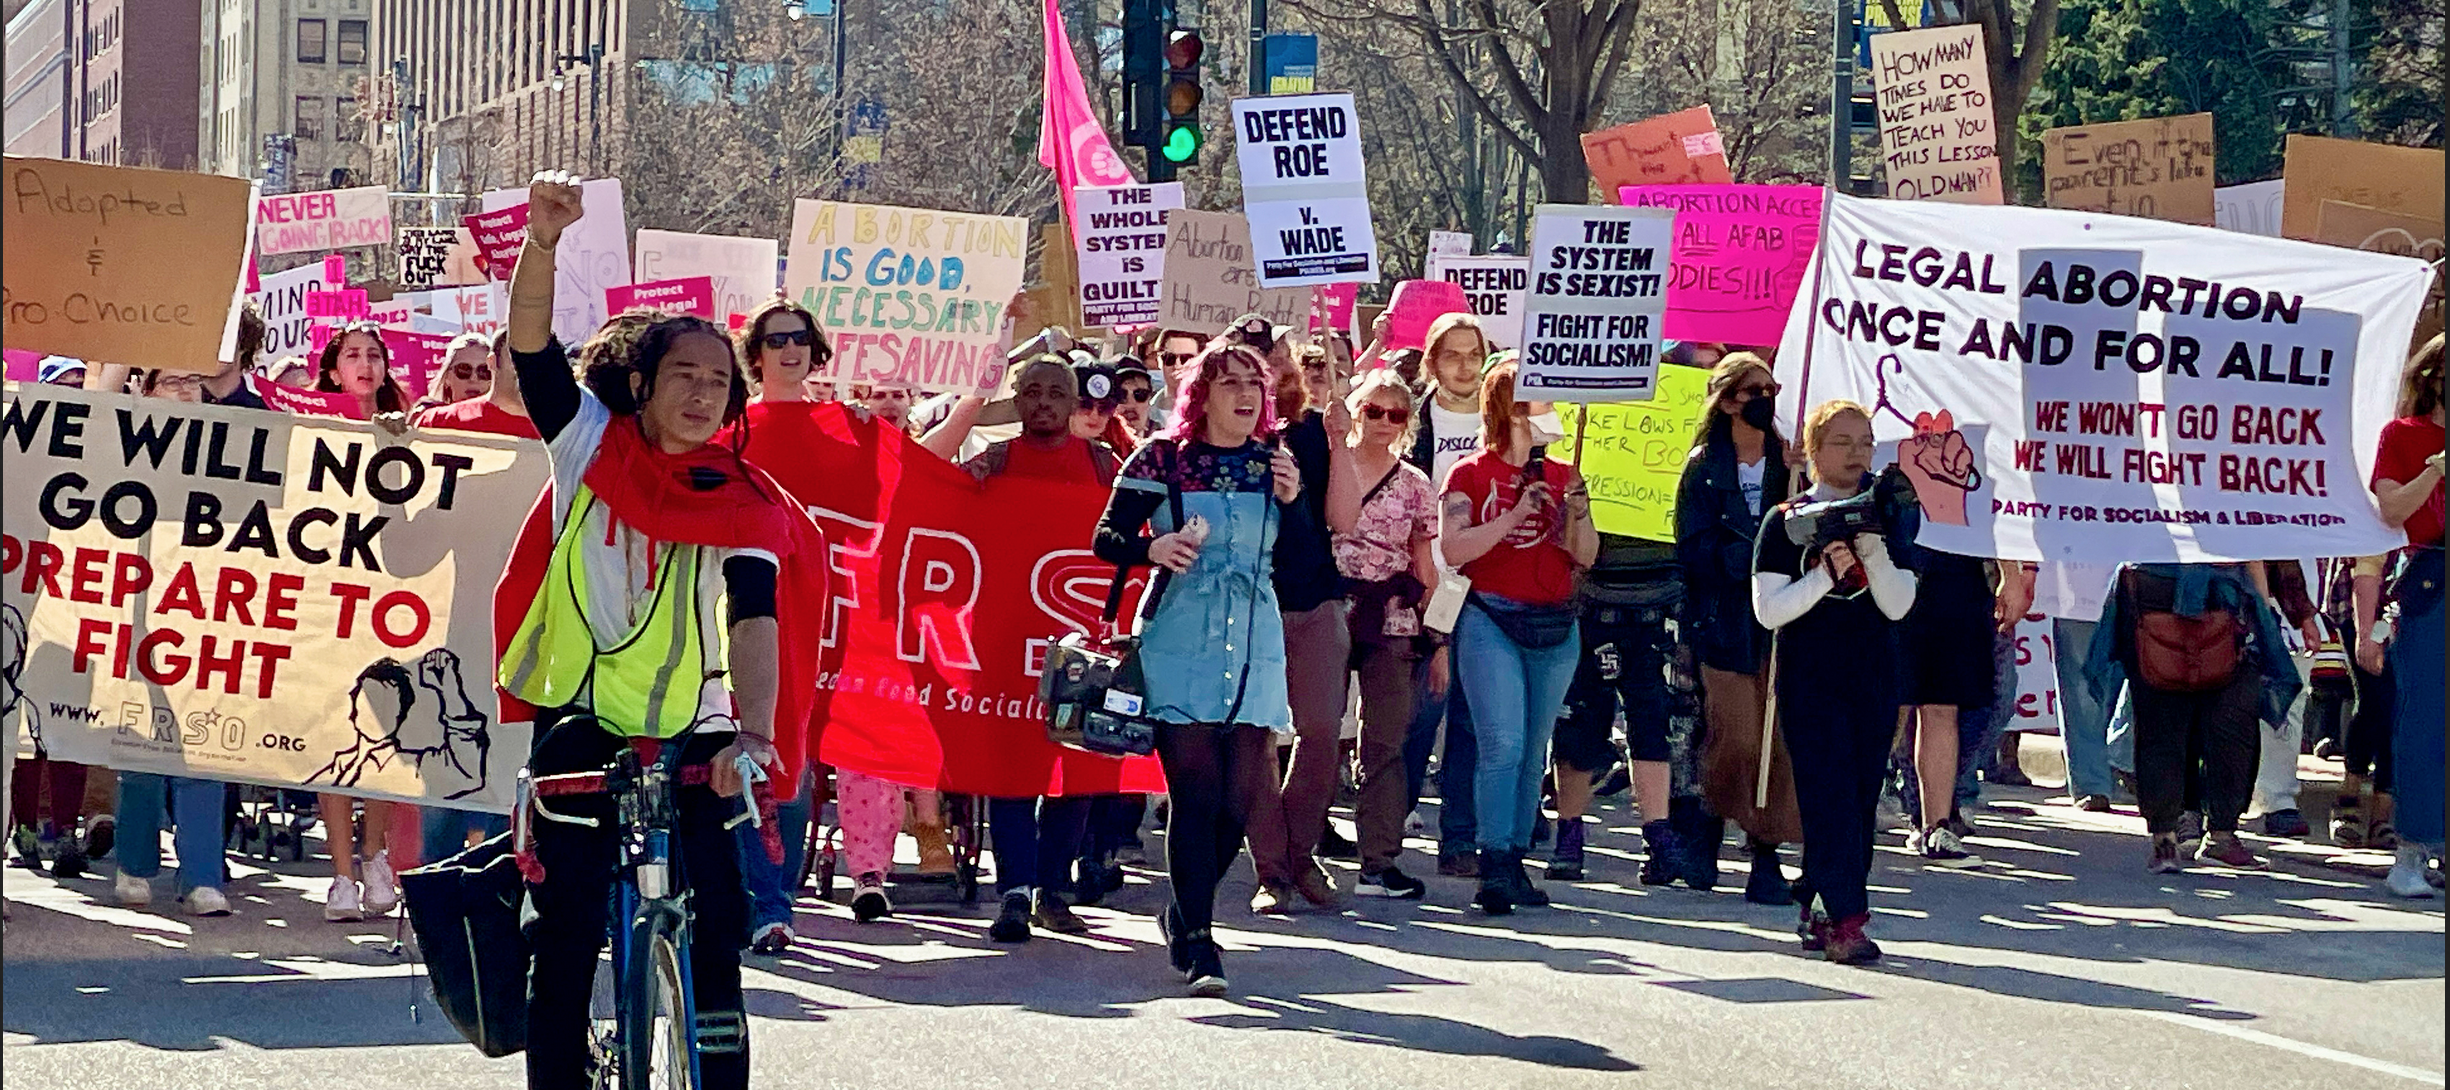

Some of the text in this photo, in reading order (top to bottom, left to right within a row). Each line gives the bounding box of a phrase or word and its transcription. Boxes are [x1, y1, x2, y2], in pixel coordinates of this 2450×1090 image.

[1880, 35, 1974, 84] HOW MANY
[1880, 73, 1970, 107] TIMES DO
[1882, 90, 1985, 123] WE HAVE TO
[1243, 106, 1346, 143] DEFEND
[1884, 117, 1987, 149] TEACH YOU
[1273, 145, 1329, 178] ROE
[1888, 145, 1998, 171] THIS LESSON
[14, 168, 187, 226] Adopted
[1108, 188, 1152, 206] THE
[1638, 192, 1760, 214] ABORTION
[1896, 175, 1947, 200] OLD
[257, 194, 336, 224] NEVER
[1090, 210, 1169, 229] WHOLE
[1299, 207, 1318, 225] V.
[261, 215, 391, 252] GOING BACK!
[808, 204, 1021, 258] ABORTION
[1167, 221, 1243, 262] Abortion
[1280, 226, 1346, 256] WADE
[1584, 220, 1631, 243] THE
[1681, 222, 1785, 251] ALL AFAB
[406, 256, 446, 274] FUCK
[821, 247, 853, 282] IS
[865, 247, 971, 293] GOOD,
[1551, 247, 1654, 271] SYSTEM
[405, 270, 435, 284] OUT
[634, 284, 683, 300] Protect
[1083, 279, 1162, 301] GUILT
[1221, 266, 1256, 288] are
[1445, 268, 1527, 290] DEFEND
[1536, 272, 1661, 297] IS SEXIST!
[1667, 261, 1771, 299] ODIES!!!
[1856, 239, 2303, 325] LEGAL ABORTION
[64, 293, 194, 326] Choice
[455, 293, 488, 315] WE
[660, 296, 697, 313] Legal
[802, 286, 1003, 335] NECESSARY
[1172, 281, 1236, 323] Human
[1466, 293, 1508, 315] ROE
[266, 318, 315, 353] OUR
[1537, 314, 1649, 339] FIGHT FOR
[1823, 298, 2334, 387] ONCE AND FOR ALL!
[1527, 343, 1653, 368] SOCIALISM!
[2035, 401, 2327, 446] WE WON'T GO BACK
[3, 399, 474, 511] WE WILL NOT
[2014, 439, 2328, 498] WE WILL FIGHT BACK!
[39, 471, 391, 572] GO BACK
[1991, 499, 2052, 520] PARTY
[2058, 505, 2098, 521] FOR
[2104, 508, 2211, 525] SOCIALISM
[2216, 511, 2230, 525] &
[3, 532, 432, 649] PREPARE TO
[72, 617, 292, 699] FIGHT
[944, 687, 1054, 721] Sociali
[255, 732, 308, 753] .ORG
